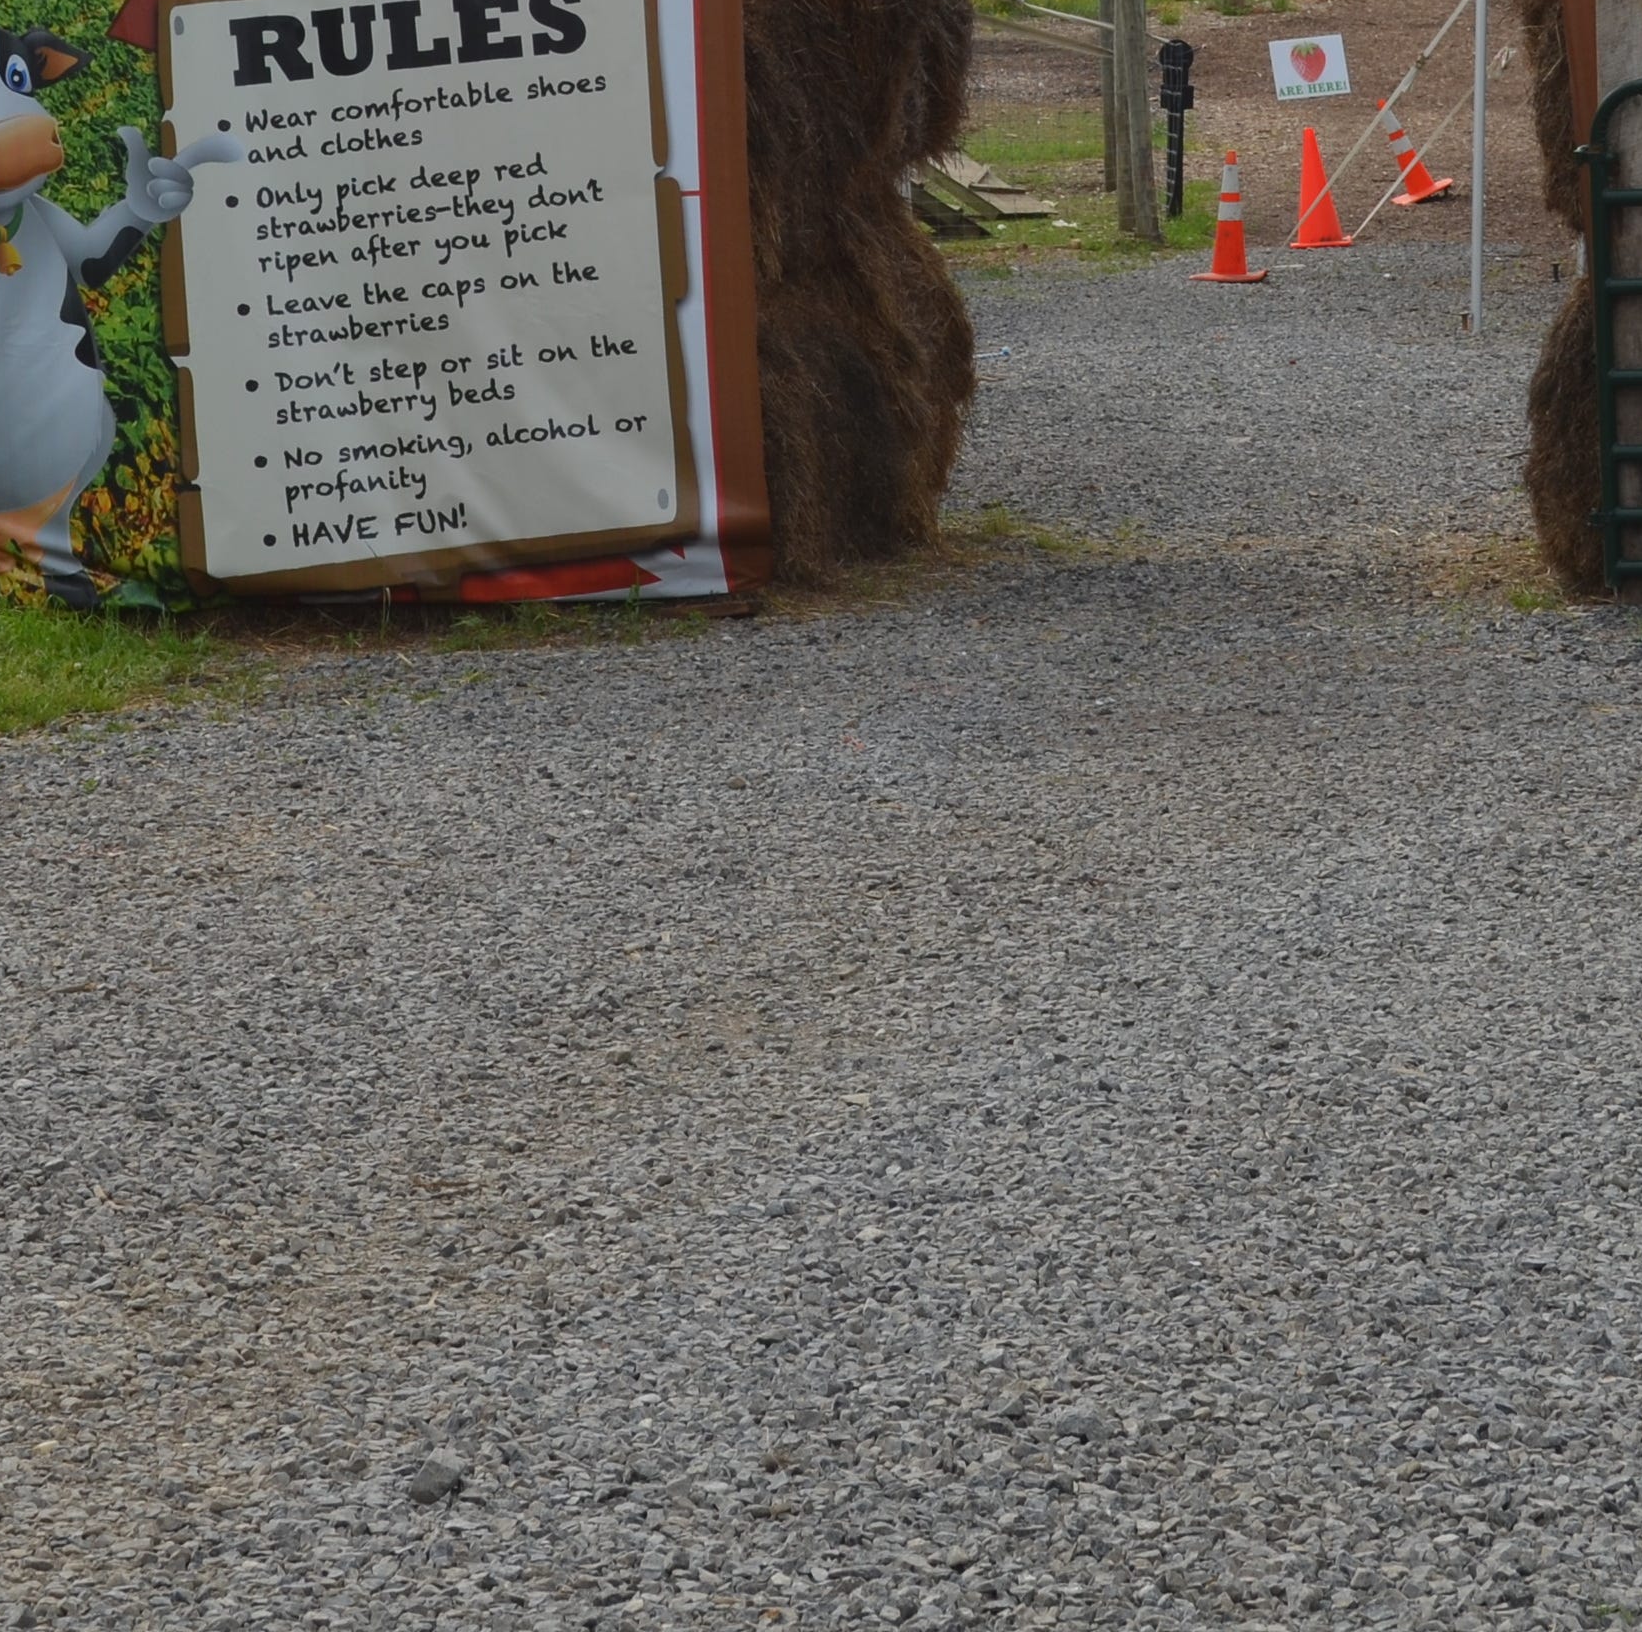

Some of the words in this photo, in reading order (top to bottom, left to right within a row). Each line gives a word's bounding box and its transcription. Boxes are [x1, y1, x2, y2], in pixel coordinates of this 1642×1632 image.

[246, 109, 317, 133] Wear
[331, 81, 513, 121] comfortable
[527, 74, 607, 100] shoes
[1278, 85, 1304, 98] ARE
[1308, 80, 1347, 94] HERE!
[247, 135, 308, 164] and
[320, 127, 423, 156] clothes
[256, 182, 322, 214] Only
[336, 173, 397, 209] pick
[409, 166, 480, 196] deep
[494, 152, 547, 181] red
[258, 250, 338, 282] ripen
[351, 234, 421, 267] after
[435, 233, 490, 265] you
[504, 219, 568, 257] pick
[266, 291, 352, 316] Leave
[363, 282, 409, 305] the
[422, 279, 485, 307] caps
[500, 272, 539, 290] on
[552, 261, 599, 285] the
[268, 311, 450, 348] strawberries
[275, 362, 356, 392] Don't
[369, 358, 427, 389] step
[441, 355, 471, 374] or
[487, 344, 524, 370] sit
[538, 345, 578, 364] on
[591, 335, 638, 358] the
[276, 390, 437, 425] strawberry
[448, 378, 515, 407] beds
[283, 447, 323, 469] No
[338, 433, 473, 463] smoking,
[486, 415, 600, 448] alcohol
[615, 414, 647, 432] or
[285, 466, 427, 513] profanity
[292, 514, 378, 548] HAVE
[395, 503, 468, 536] FUN!
